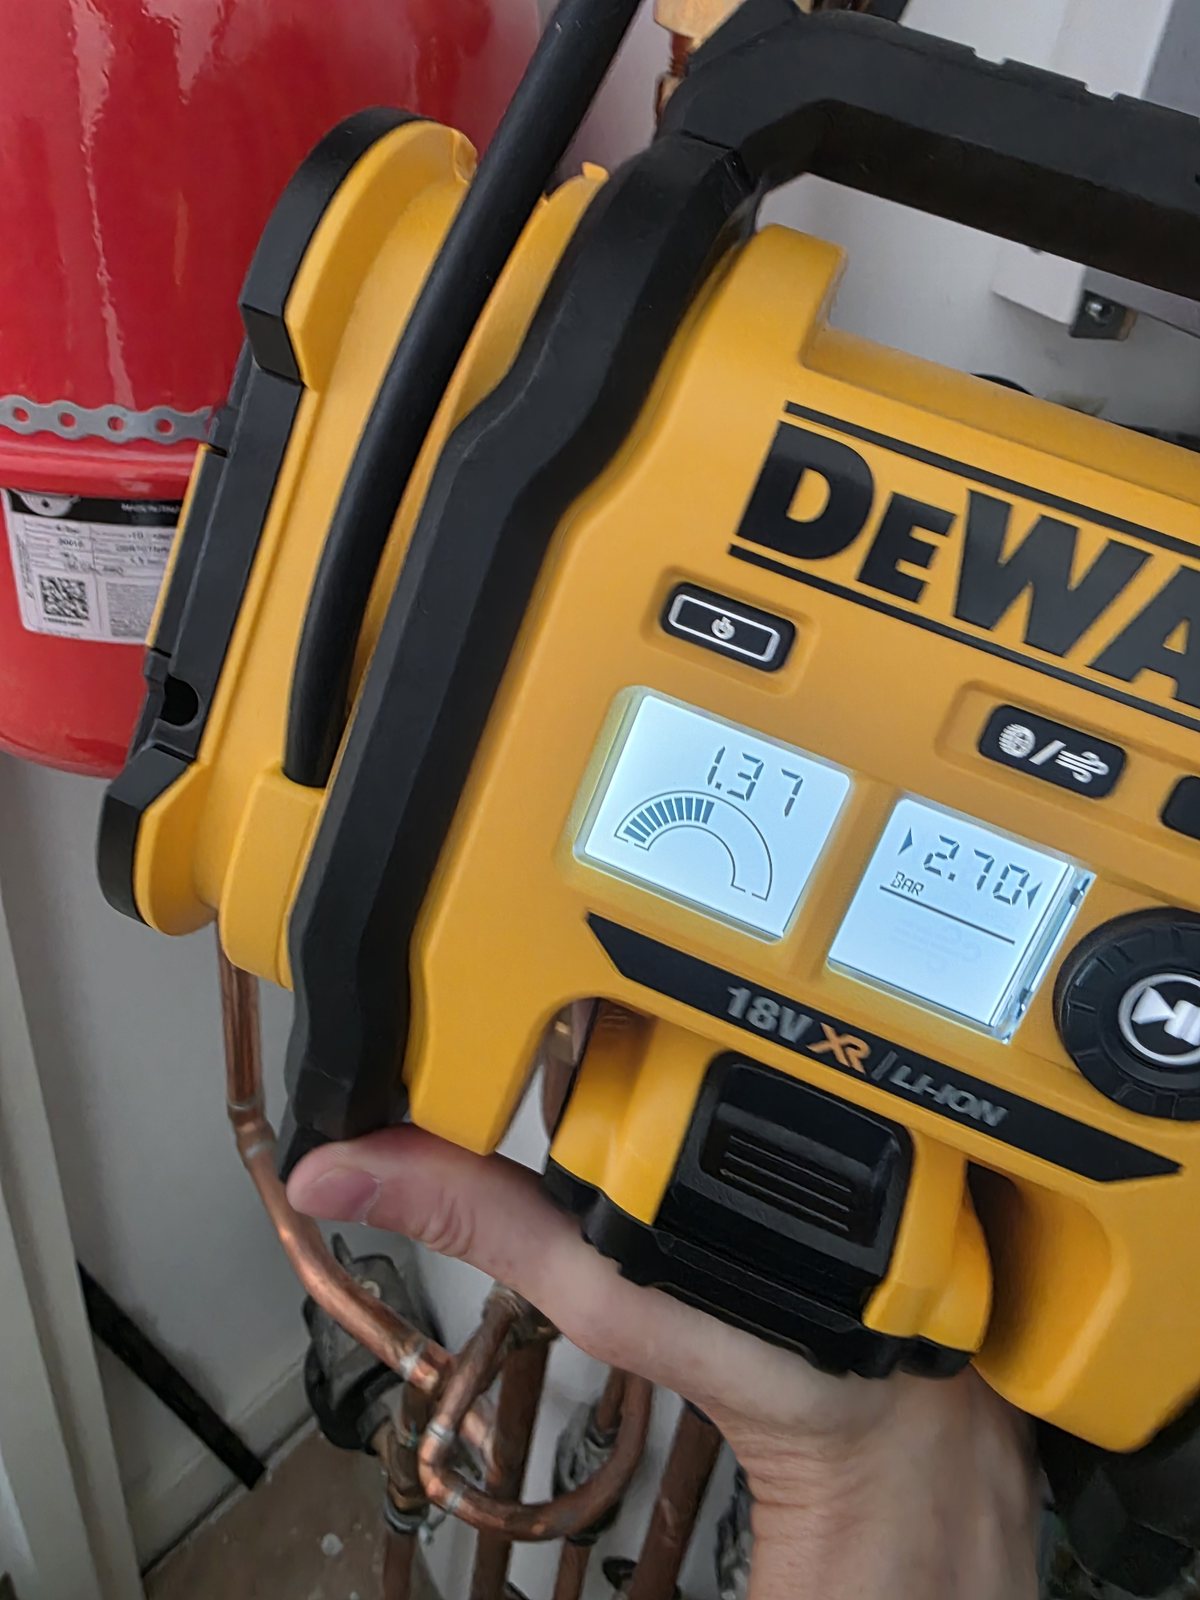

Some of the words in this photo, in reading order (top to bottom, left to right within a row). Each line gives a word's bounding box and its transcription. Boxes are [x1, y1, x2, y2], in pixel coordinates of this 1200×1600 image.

[707, 746, 803, 817] 1.37
[890, 871, 925, 897] BAR
[923, 835, 1031, 907] 2.70
[727, 986, 813, 1043] 18V
[806, 1022, 871, 1075] XR
[890, 1065, 1009, 1127] LI-ION
